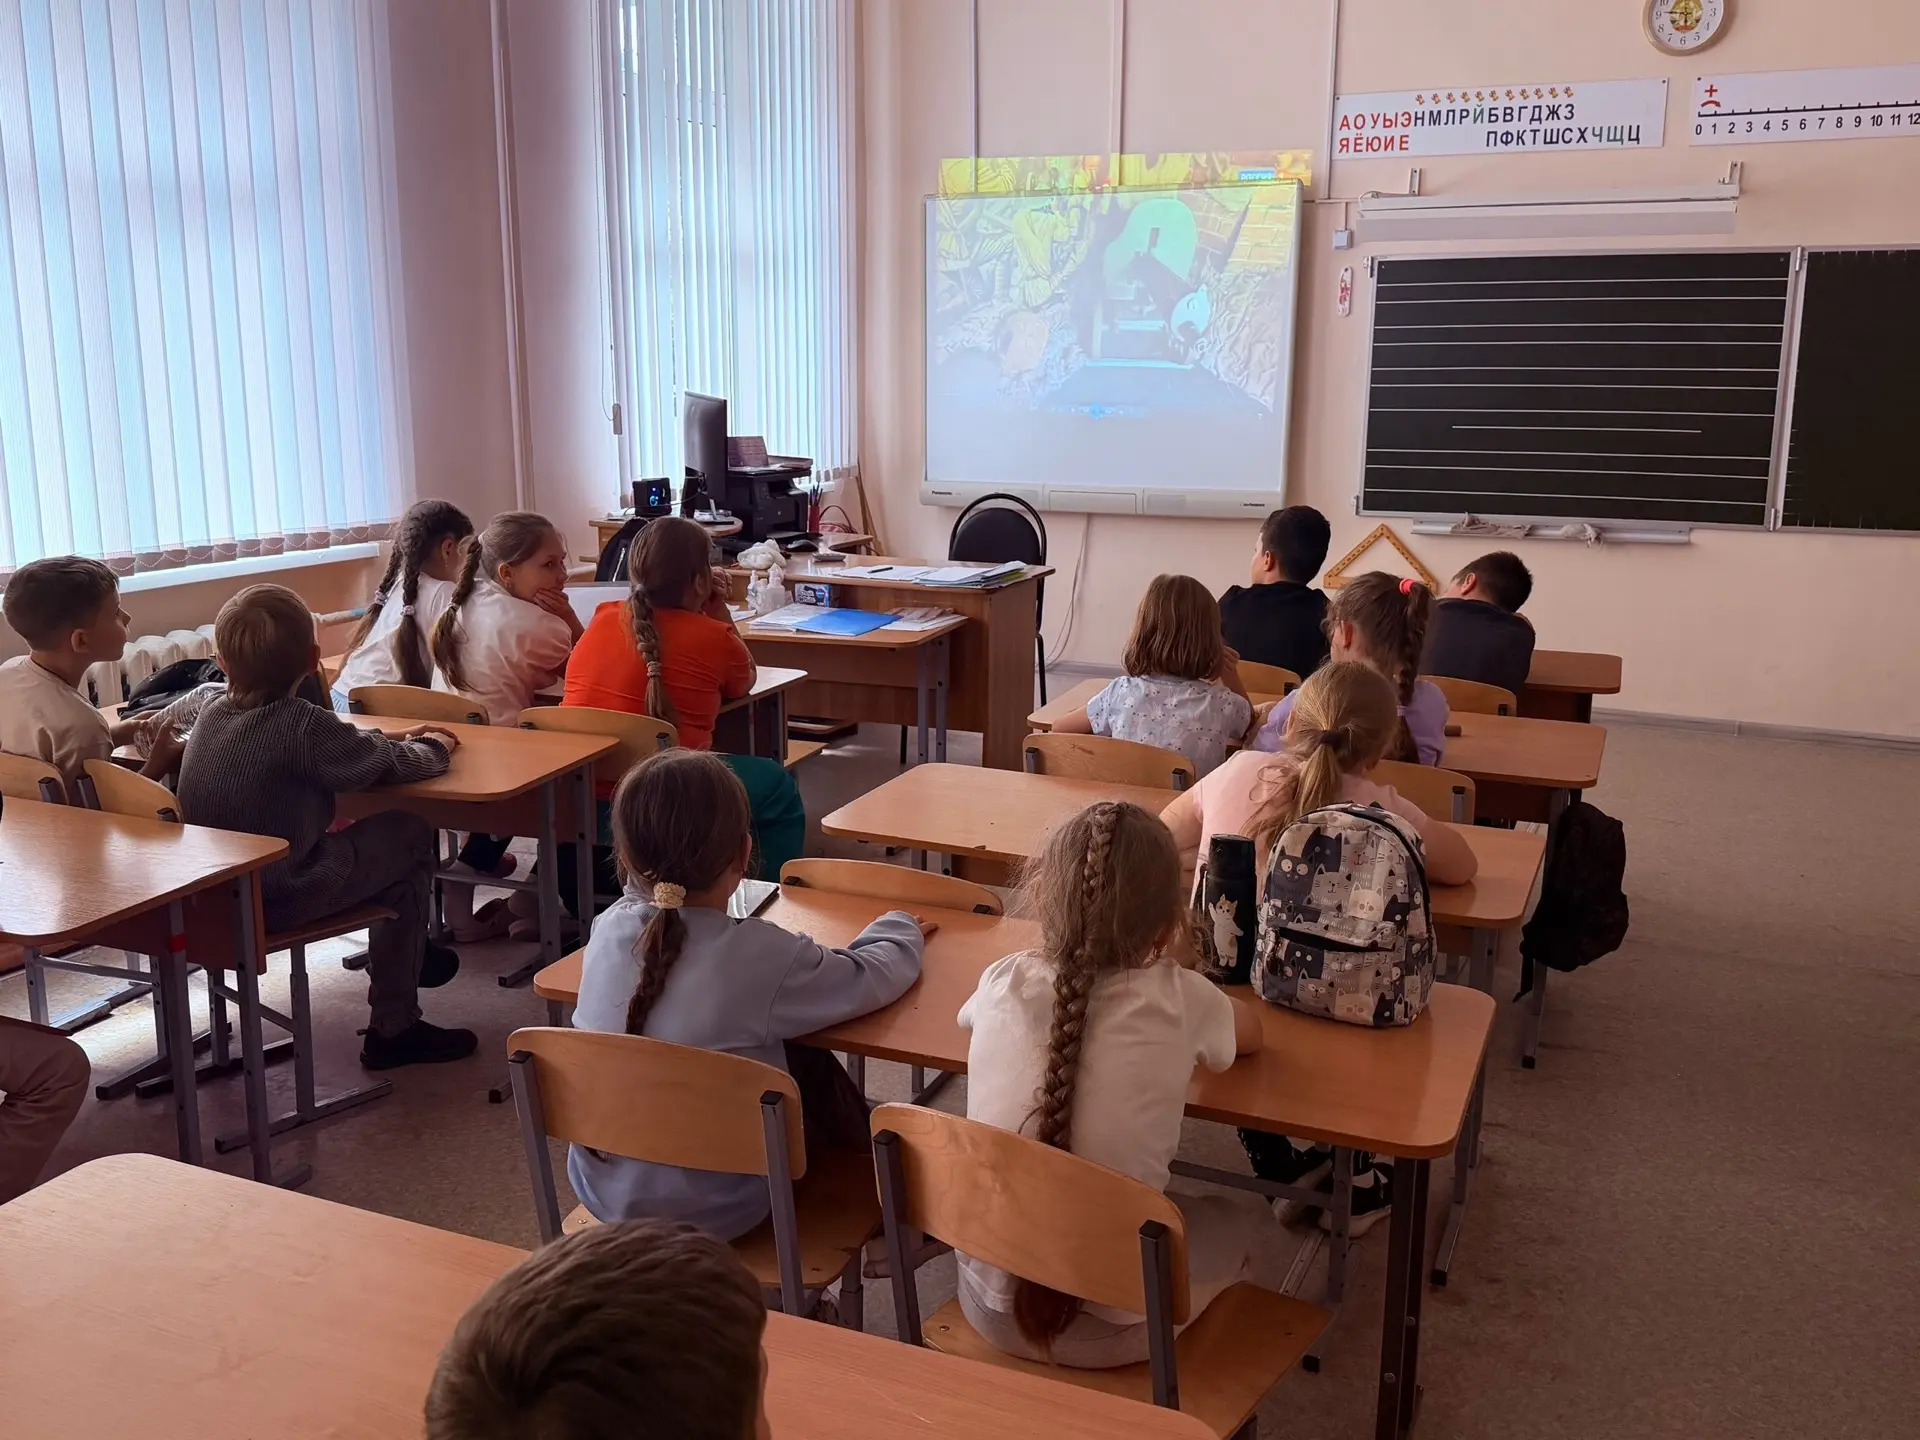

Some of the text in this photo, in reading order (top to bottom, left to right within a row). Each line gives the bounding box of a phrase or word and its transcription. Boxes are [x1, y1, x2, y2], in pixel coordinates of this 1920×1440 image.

[1695, 112, 1920, 135] 0 1 2 3 4 5 6 7 8 9 10 11 12
[1338, 124, 1641, 153] ЯЁЮИЕ ПФКТШСХЧЩЦ
